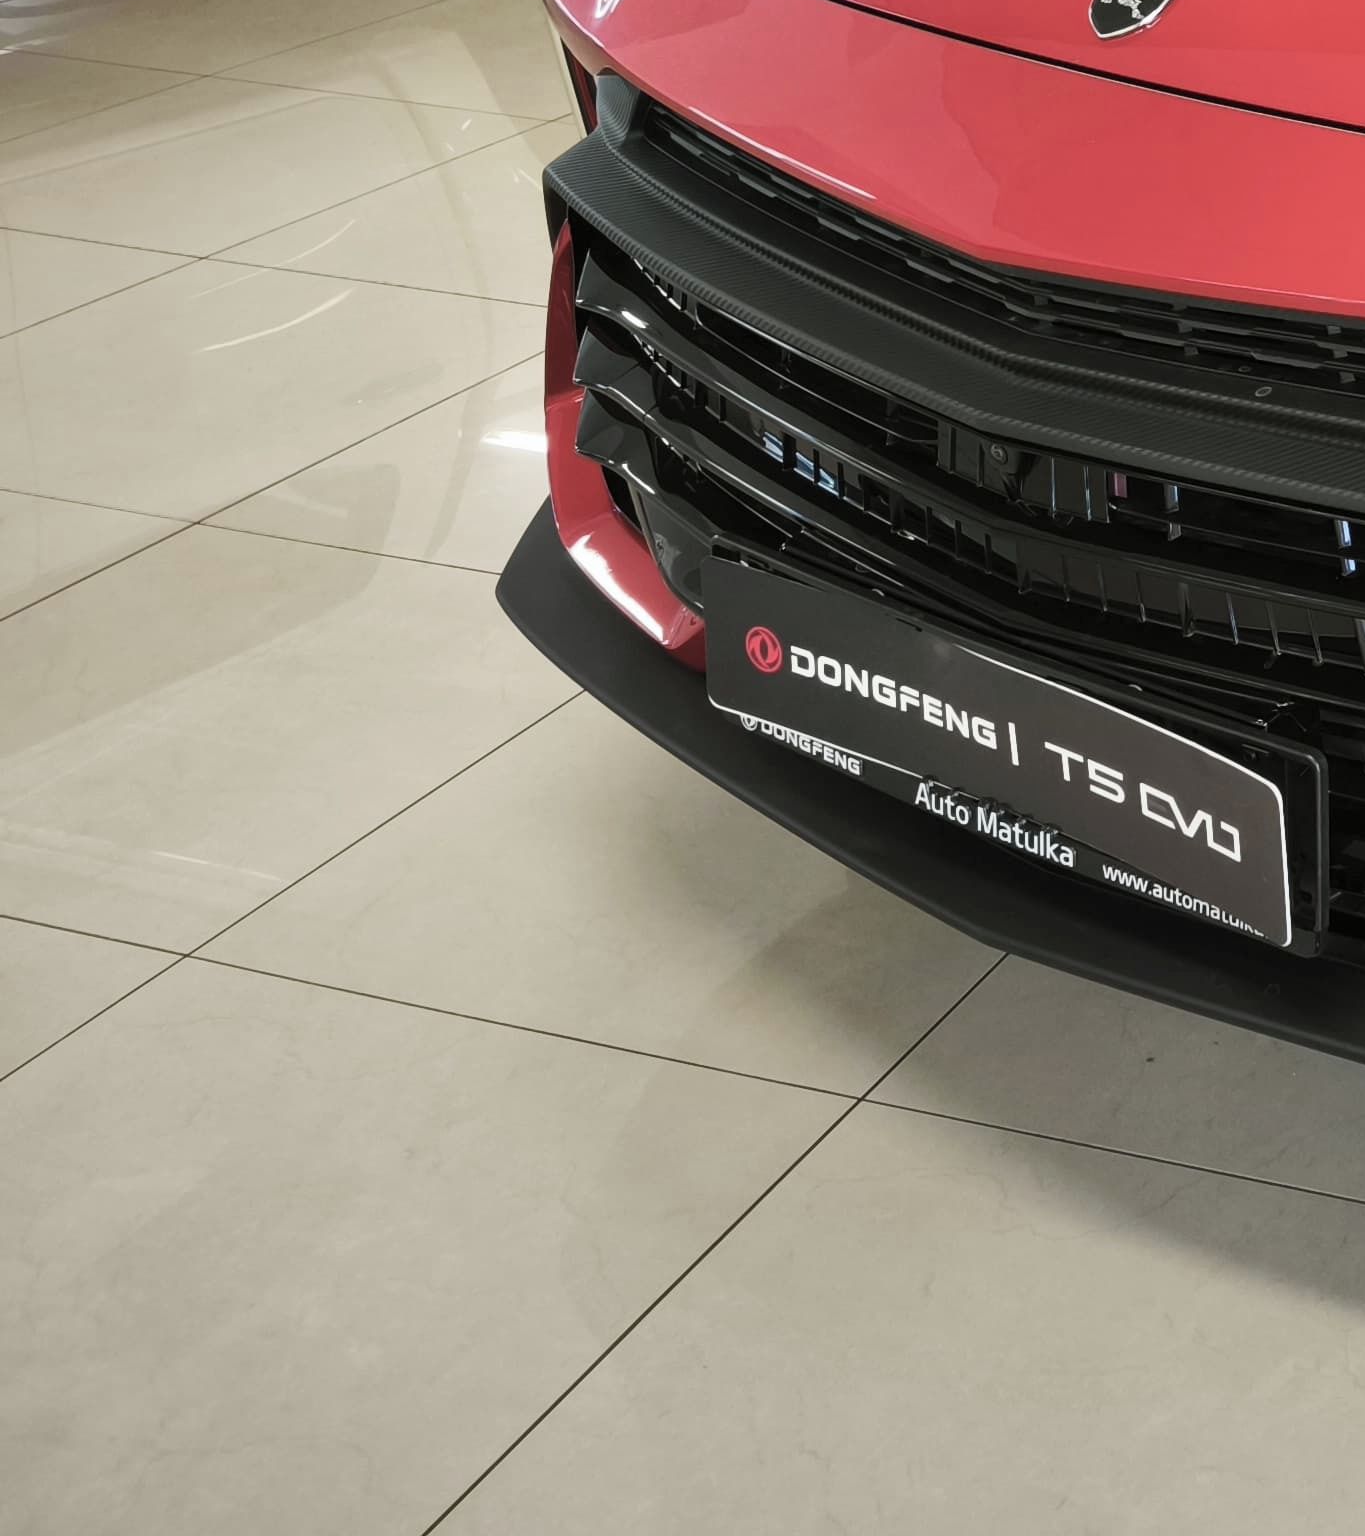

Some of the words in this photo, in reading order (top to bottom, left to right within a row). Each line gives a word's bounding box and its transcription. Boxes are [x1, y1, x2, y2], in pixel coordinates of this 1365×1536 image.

[760, 720, 861, 775] DONGFENG
[791, 645, 997, 750] DONGFENG
[1044, 741, 1125, 804] T5
[915, 782, 970, 825] Auto
[976, 806, 1074, 867] Matulka
